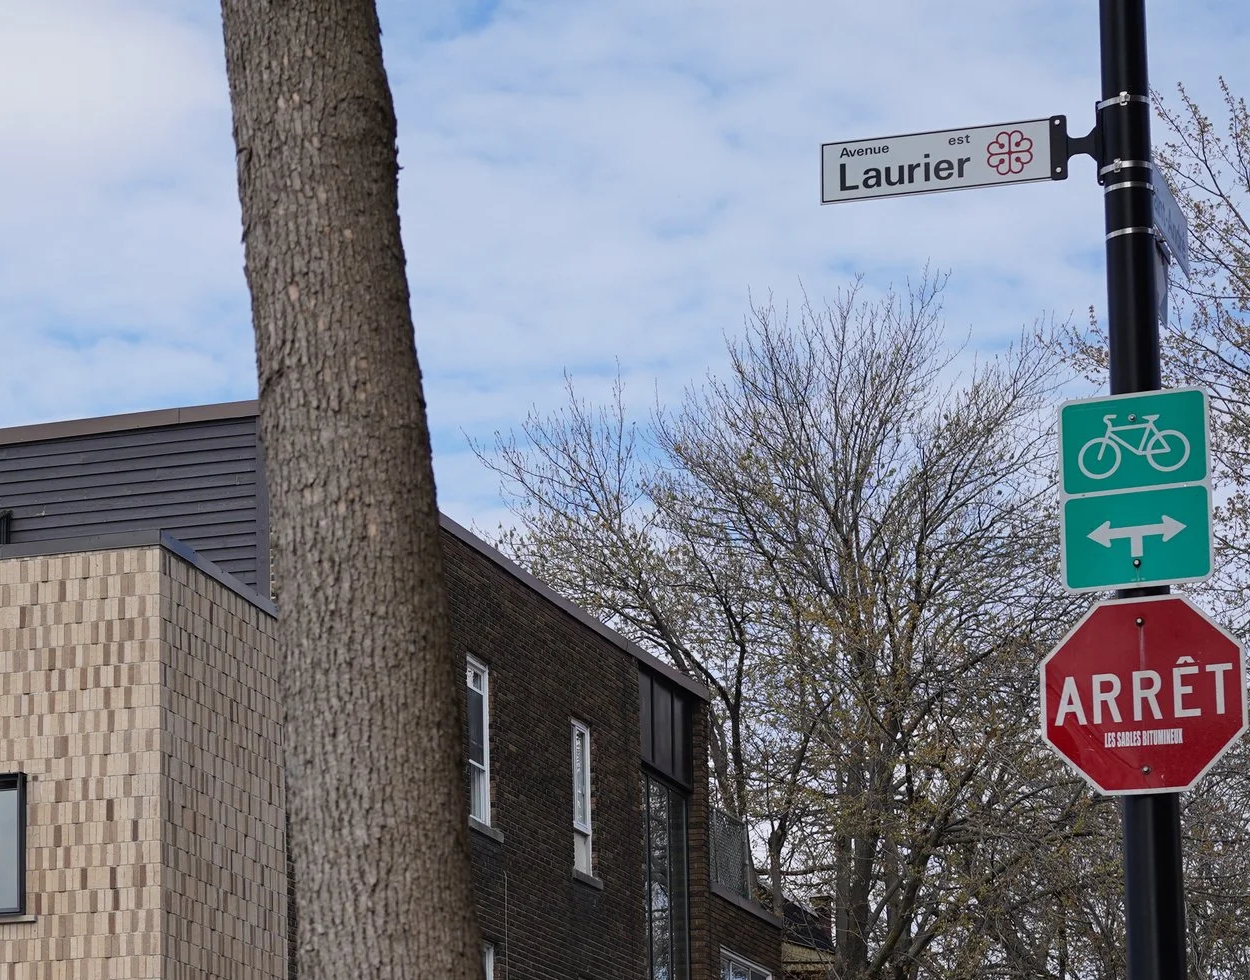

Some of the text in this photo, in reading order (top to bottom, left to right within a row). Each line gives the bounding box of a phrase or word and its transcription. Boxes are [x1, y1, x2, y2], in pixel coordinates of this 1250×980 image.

[839, 134, 971, 159] Avenue est
[839, 153, 971, 192] Laurier
[1054, 655, 1233, 726] ARRÊT
[1104, 728, 1183, 748] LES SABLES BITUMINEUX
